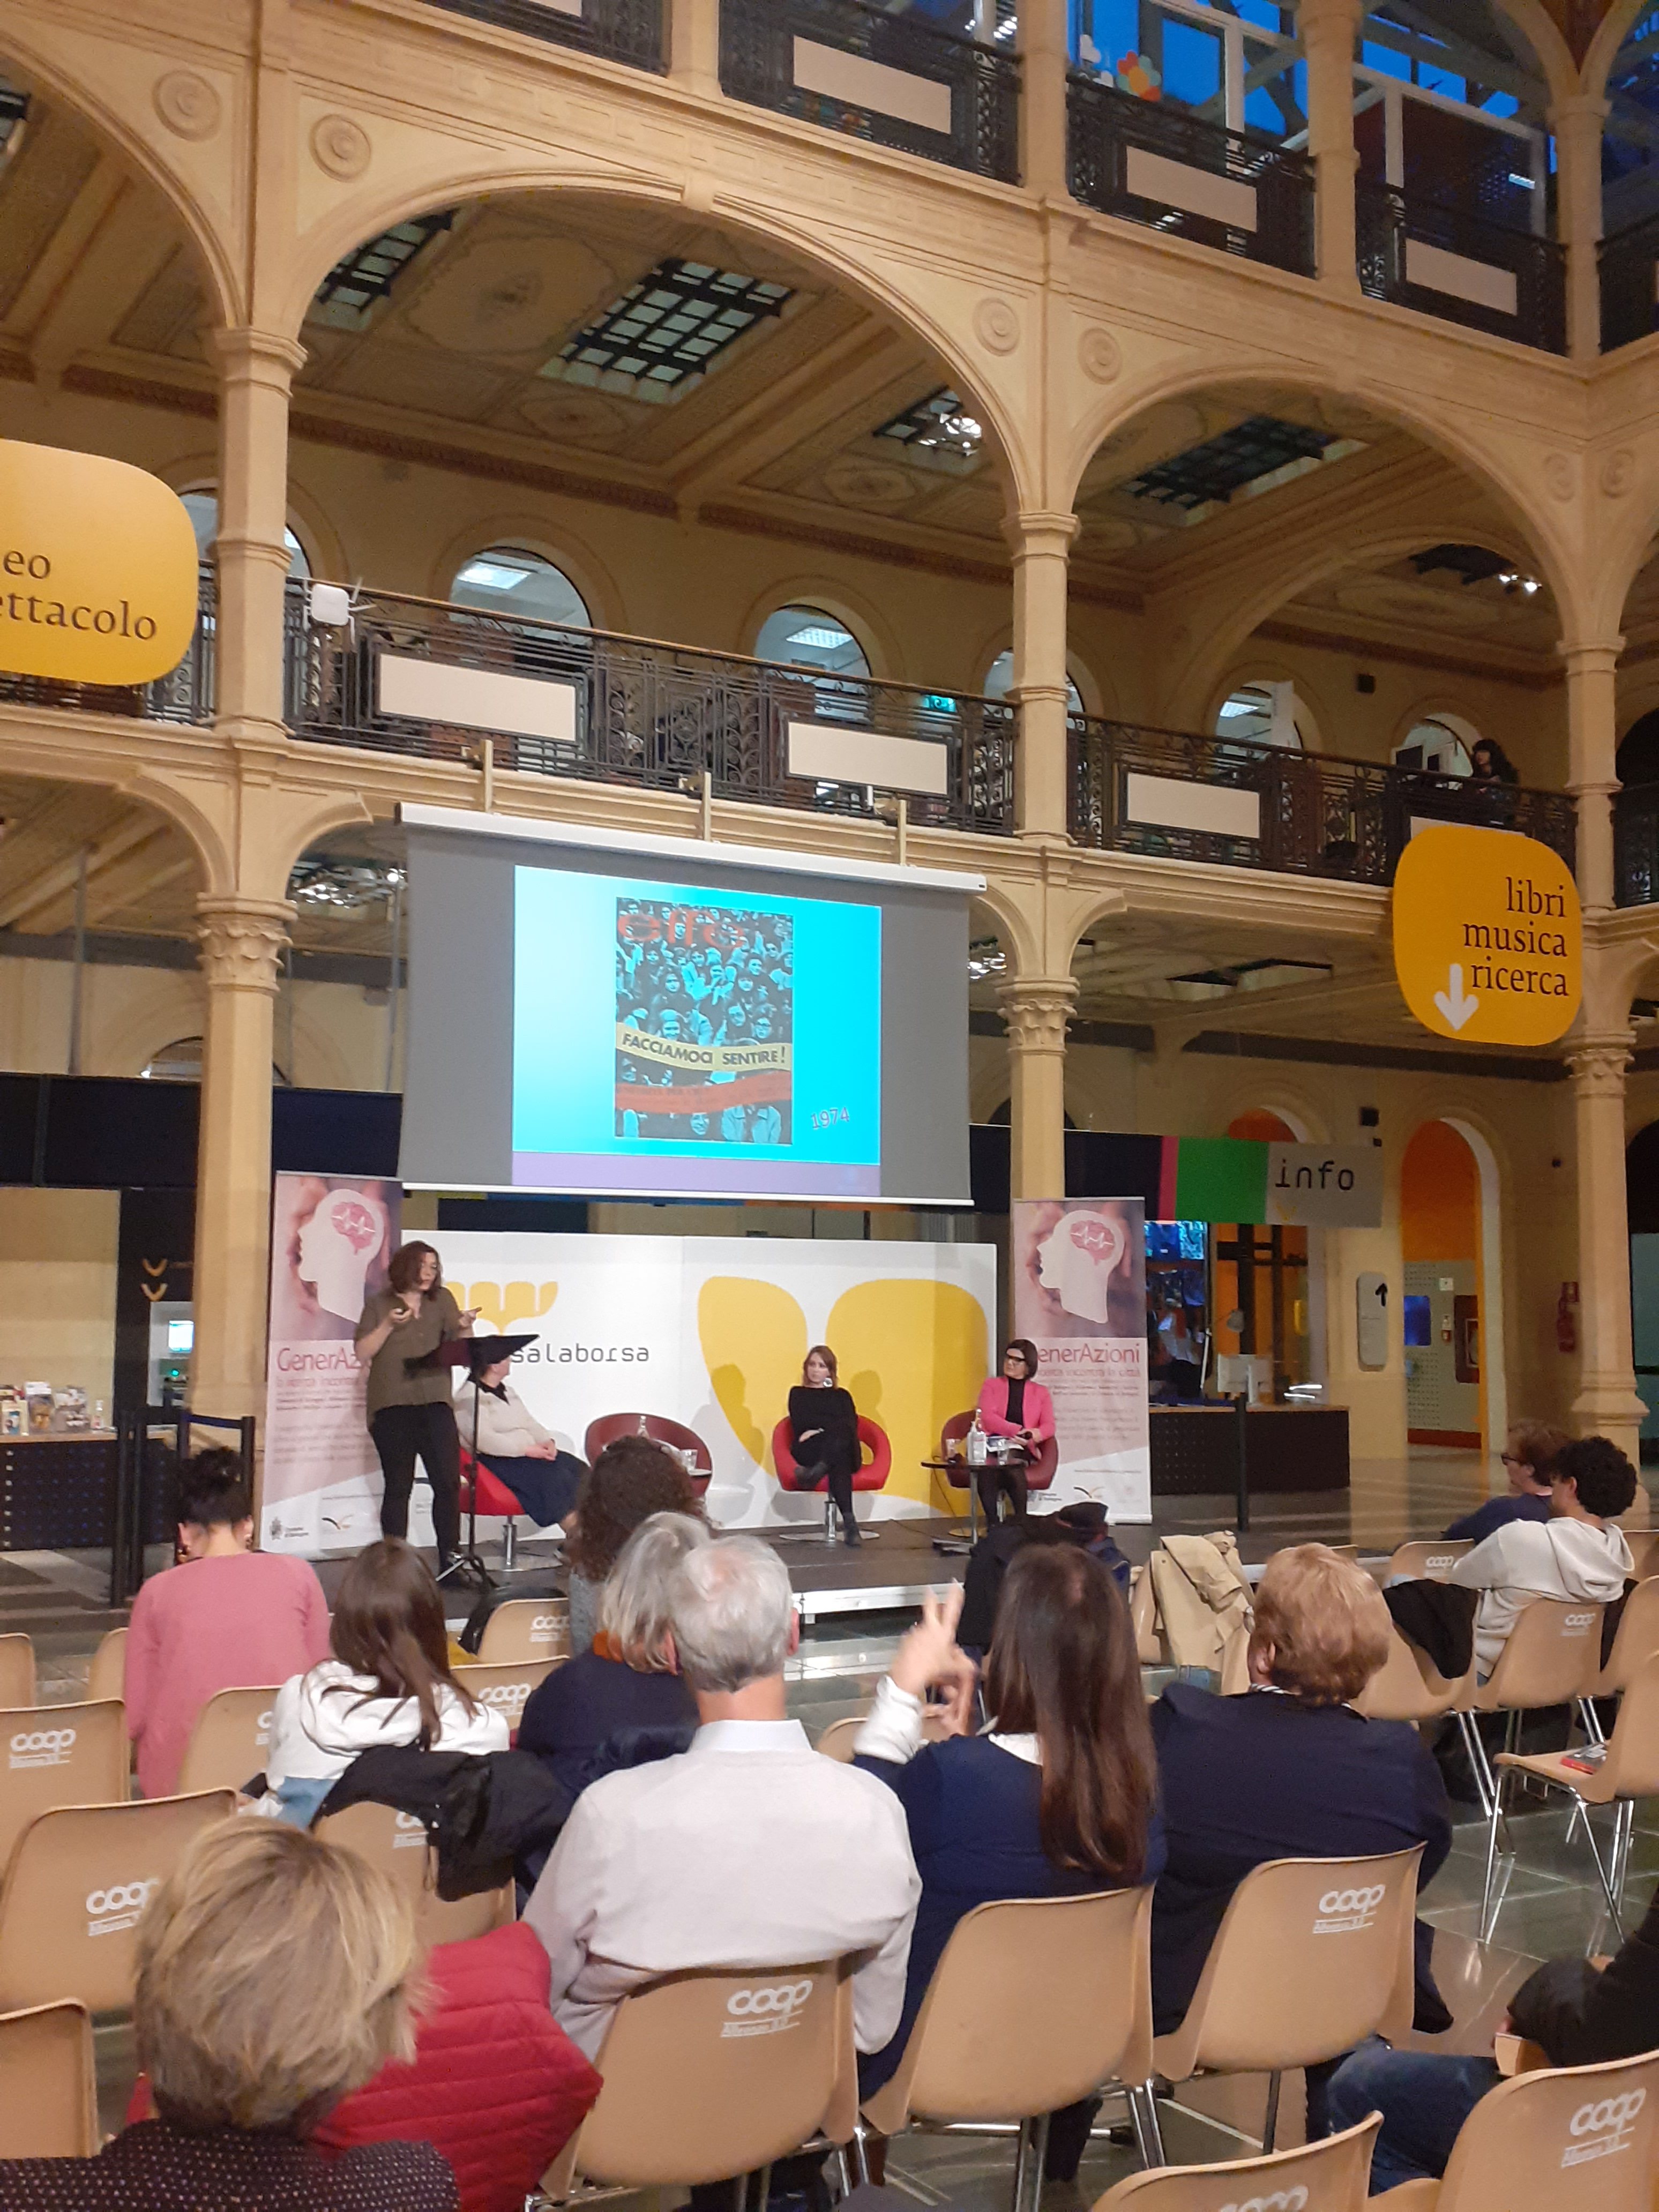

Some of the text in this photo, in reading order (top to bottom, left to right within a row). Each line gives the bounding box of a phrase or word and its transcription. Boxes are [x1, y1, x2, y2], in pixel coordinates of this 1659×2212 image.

[3, 550, 51, 579] eo
[1506, 877, 1567, 918] libri
[1462, 921, 1568, 957] musica
[1470, 956, 1569, 997] ricerca
[622, 1033, 713, 1064] FACCIAMOCI
[811, 1107, 849, 1129] 1974
[1275, 1158, 1355, 1191] info
[277, 1347, 364, 1372] GenerAz
[511, 1342, 649, 1363] salaborsa
[1037, 1343, 1140, 1363] enerAzioni
[10, 1729, 76, 1752] coop
[1319, 1884, 1386, 1914] coop
[727, 1980, 813, 2016] coop
[1570, 2088, 1647, 2136] coop
